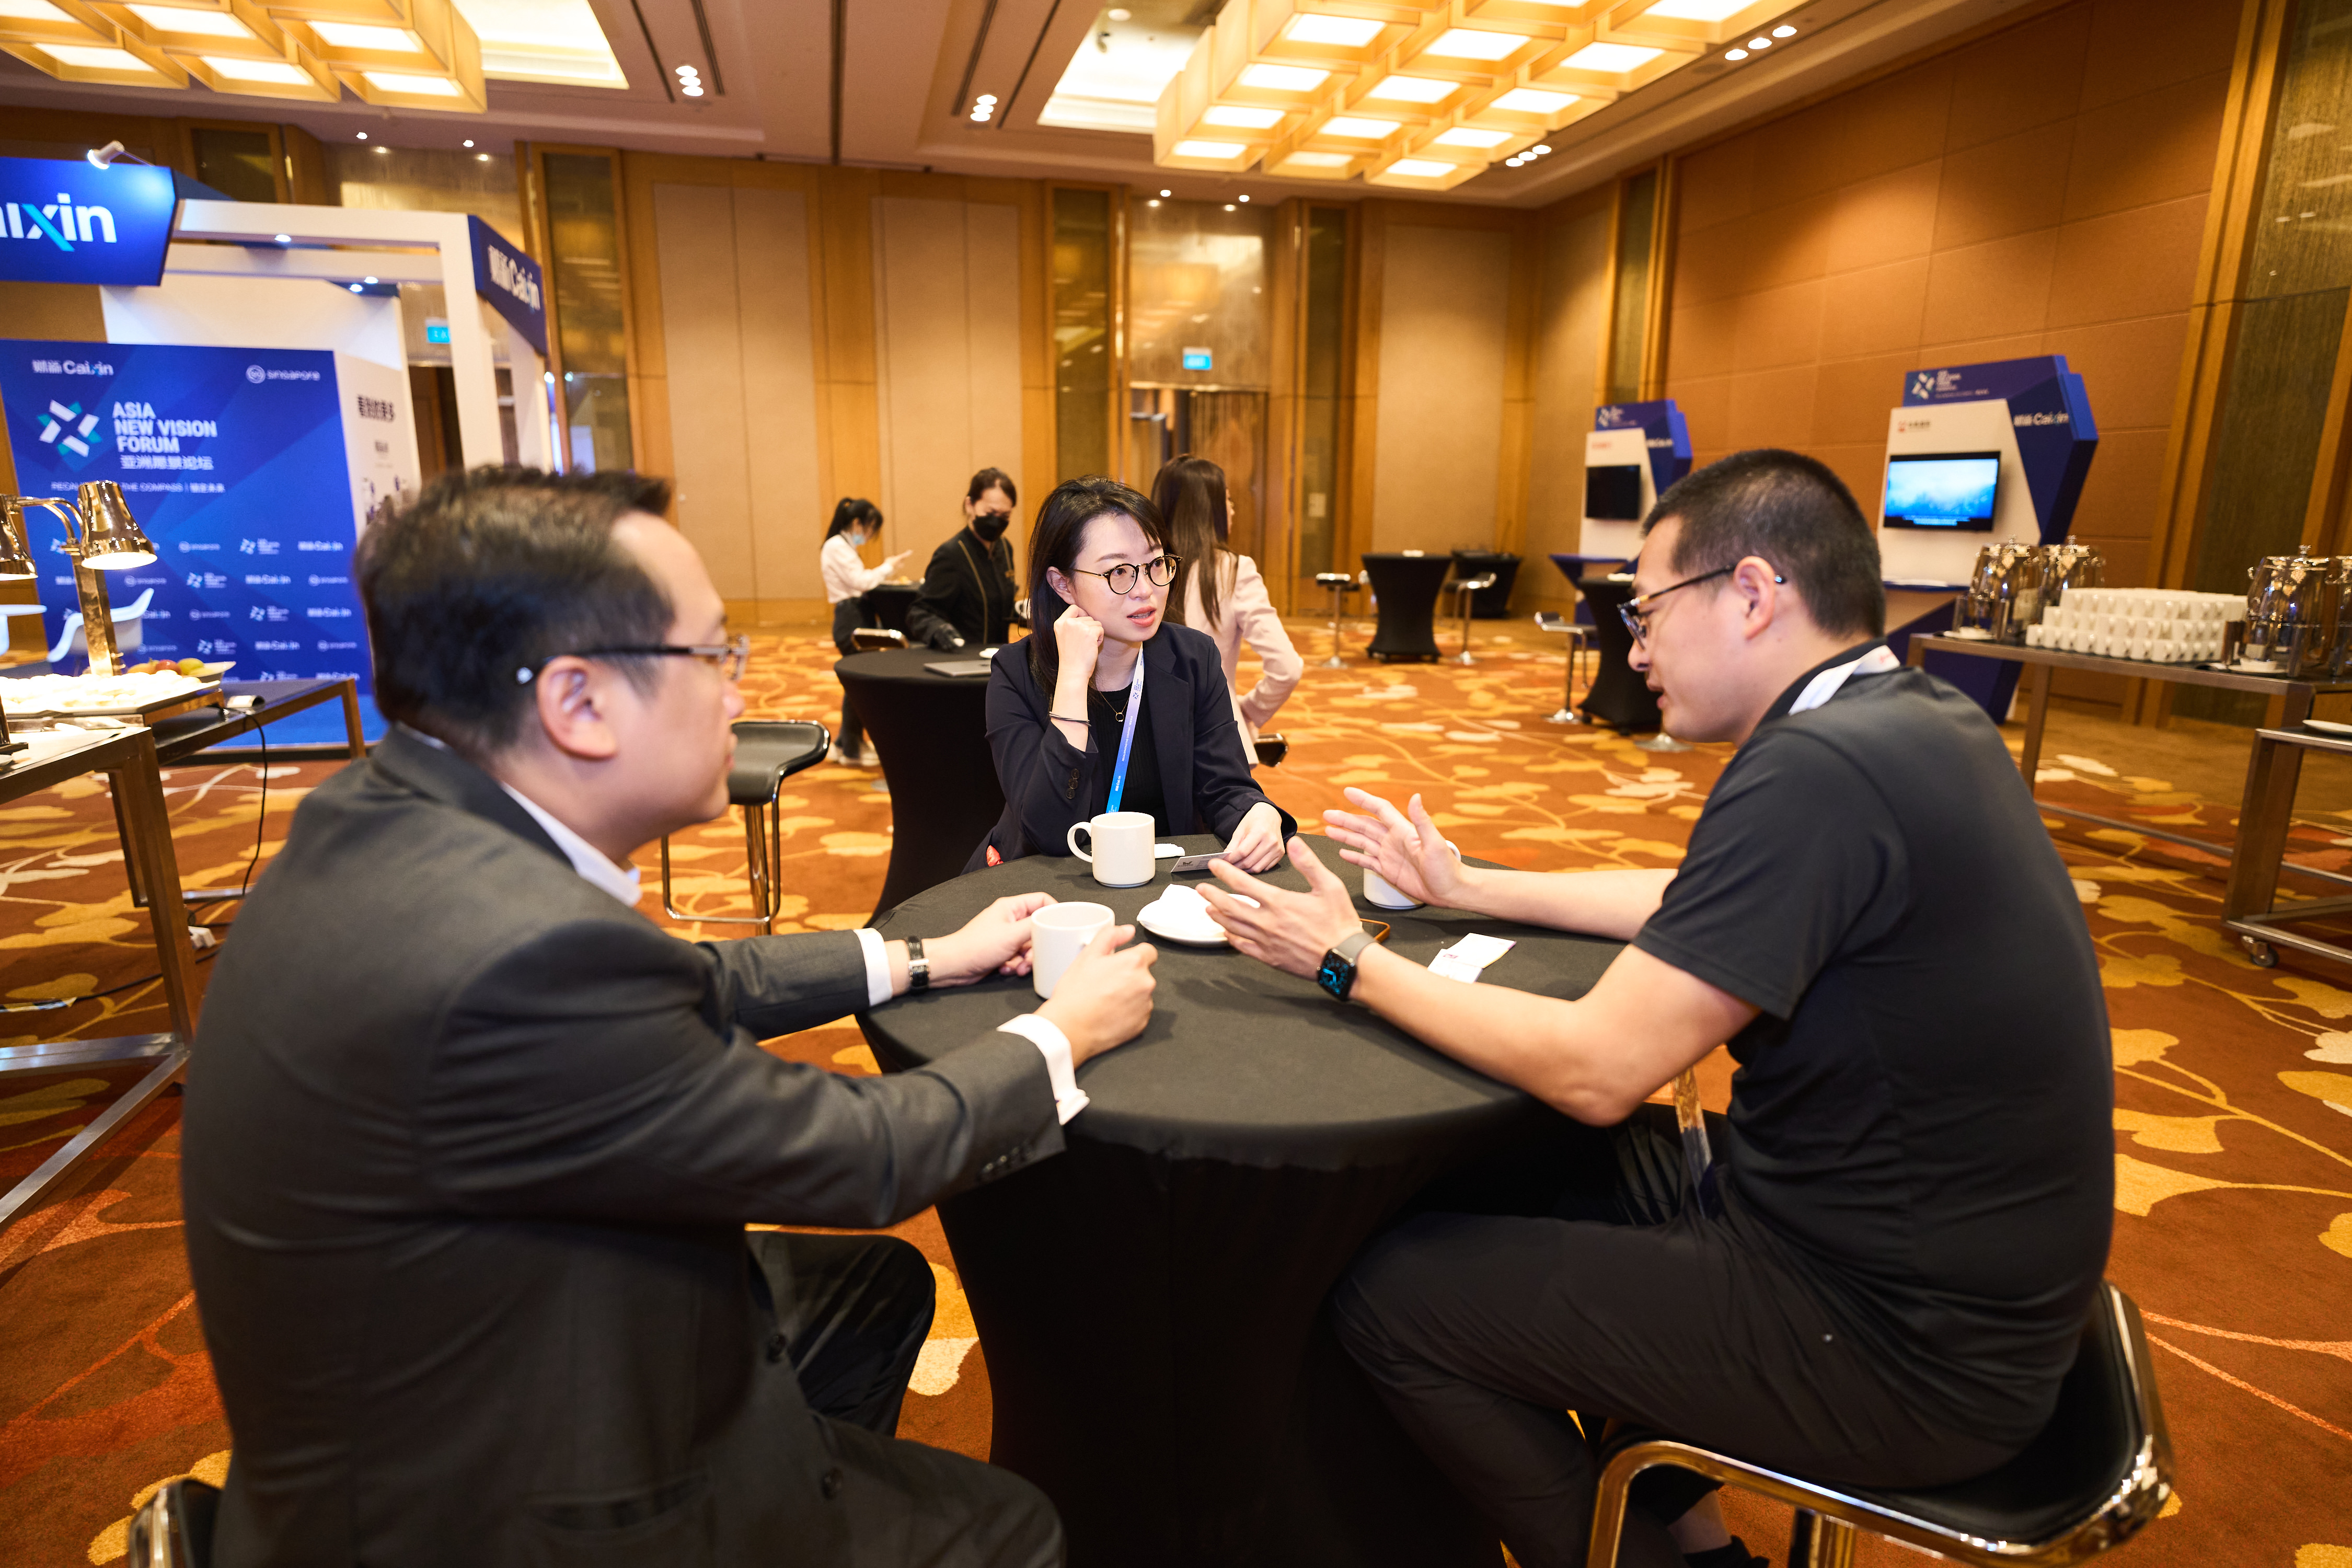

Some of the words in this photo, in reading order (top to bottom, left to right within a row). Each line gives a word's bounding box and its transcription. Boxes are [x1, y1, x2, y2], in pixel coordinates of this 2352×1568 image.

[62, 360, 114, 377] Caixin
[112, 401, 157, 419] ASIA
[113, 419, 154, 436] NEW
[156, 419, 218, 437] VISION
[117, 435, 180, 453] FORUM
